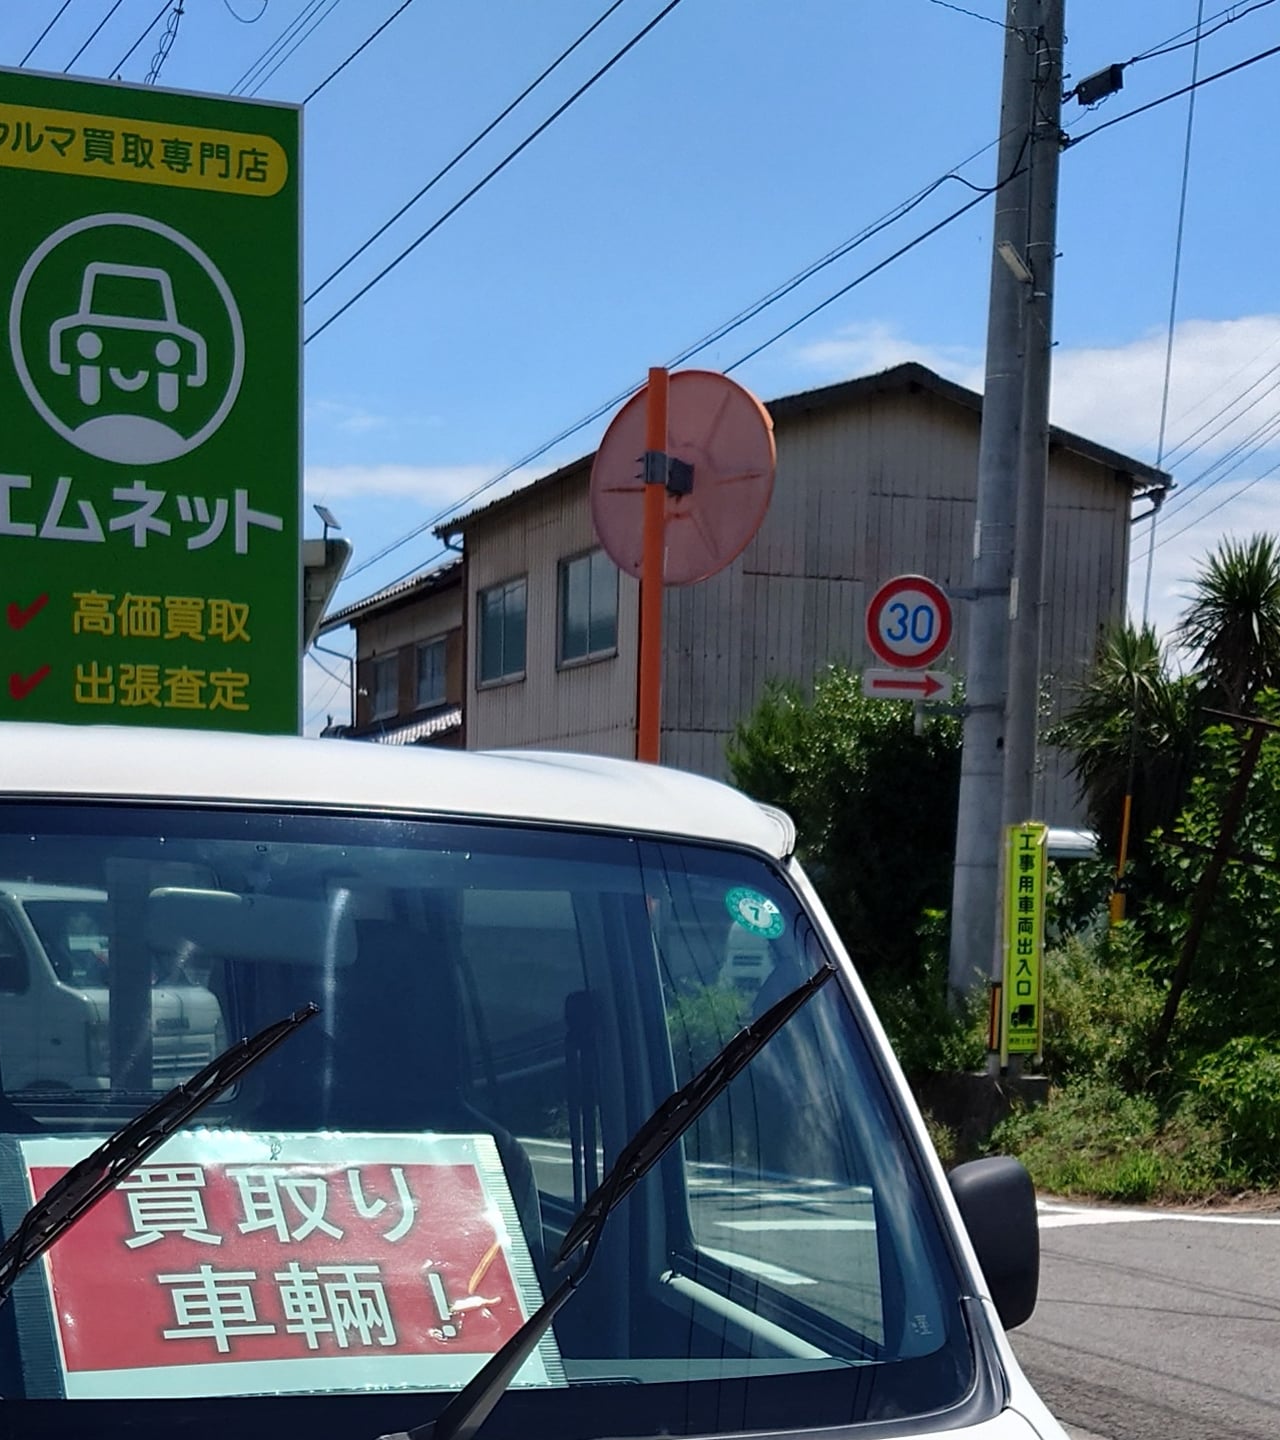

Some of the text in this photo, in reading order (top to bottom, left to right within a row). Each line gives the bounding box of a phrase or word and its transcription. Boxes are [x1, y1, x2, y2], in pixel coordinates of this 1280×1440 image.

[72, 590, 251, 642] 高価買取
[886, 603, 934, 644] 30
[74, 660, 250, 711] 出張査定
[748, 905, 760, 921] 7
[1016, 834, 1036, 996] 工事用車両出入口
[115, 1165, 417, 1249] 買取り
